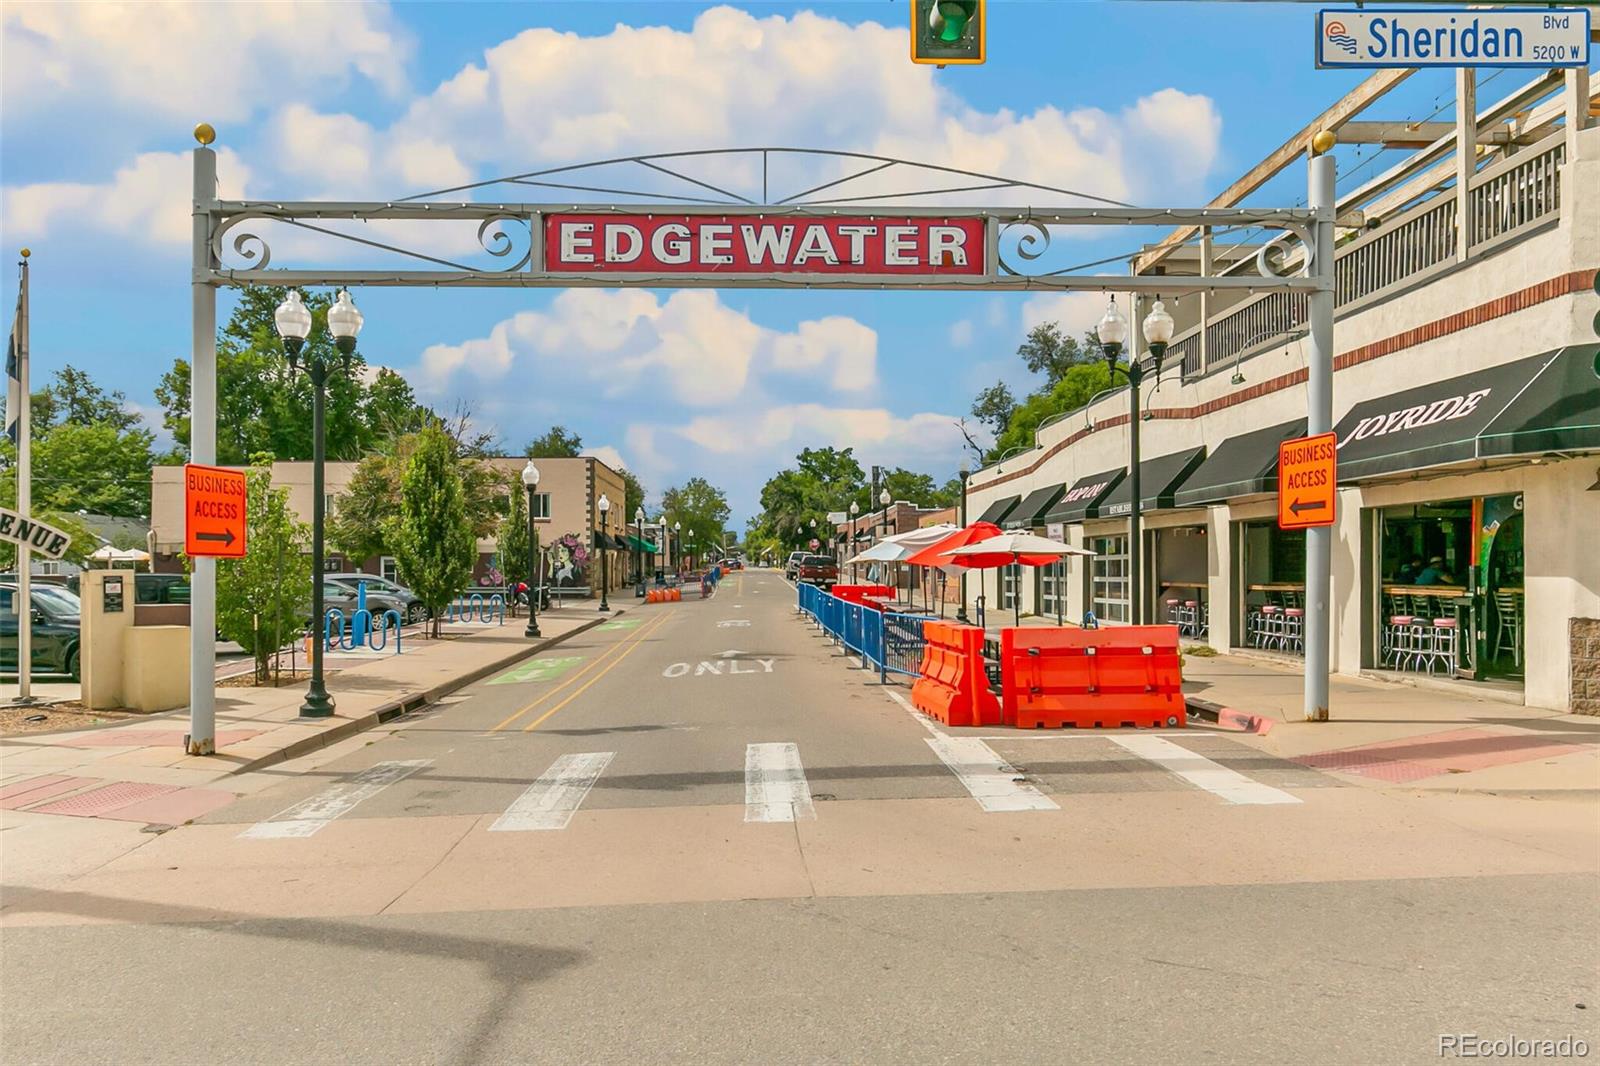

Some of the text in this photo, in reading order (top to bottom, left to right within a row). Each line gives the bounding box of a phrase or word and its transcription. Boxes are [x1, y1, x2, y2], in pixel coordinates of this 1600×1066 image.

[1368, 15, 1569, 58] Sheridan Blvd
[1533, 45, 1580, 60] 5200 W
[559, 222, 969, 267] EDGEWATER
[1336, 388, 1491, 450] JOYRIDE
[1284, 442, 1333, 466] BUSINESS
[189, 474, 242, 496] BUSINESS
[1288, 468, 1327, 490] ACCESS
[194, 500, 238, 520] ACCESS
[662, 658, 776, 678] ONLY
